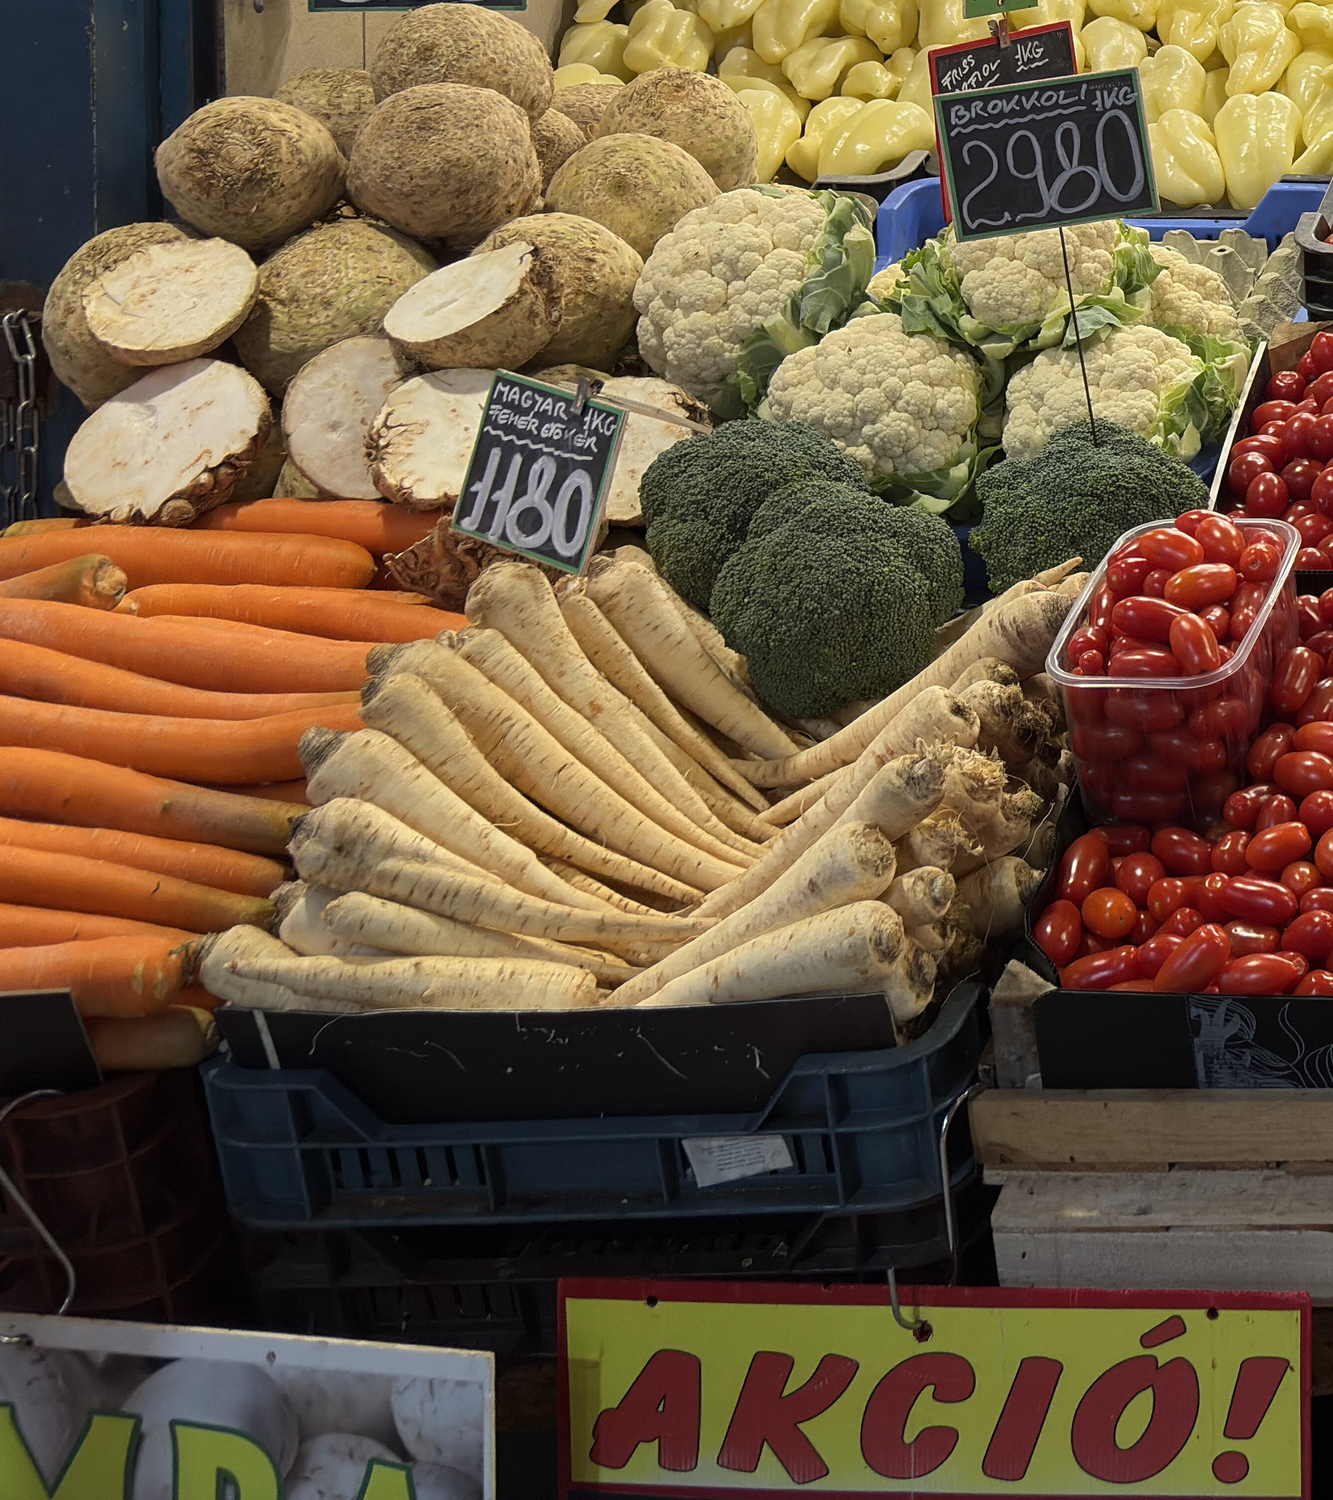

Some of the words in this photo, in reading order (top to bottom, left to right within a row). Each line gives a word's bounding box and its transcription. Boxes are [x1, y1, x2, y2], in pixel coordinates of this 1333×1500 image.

[941, 55, 975, 90] FRISS
[1015, 41, 1044, 65] 1KG
[950, 83, 1087, 125] BROKKOLI
[1092, 86, 1137, 112] 1KG
[962, 109, 1144, 229] 2980
[493, 383, 568, 420] MAGYAR
[584, 408, 617, 436] 1KG
[460, 447, 593, 558] 1180
[588, 1314, 1291, 1485] AKCIÓ!
